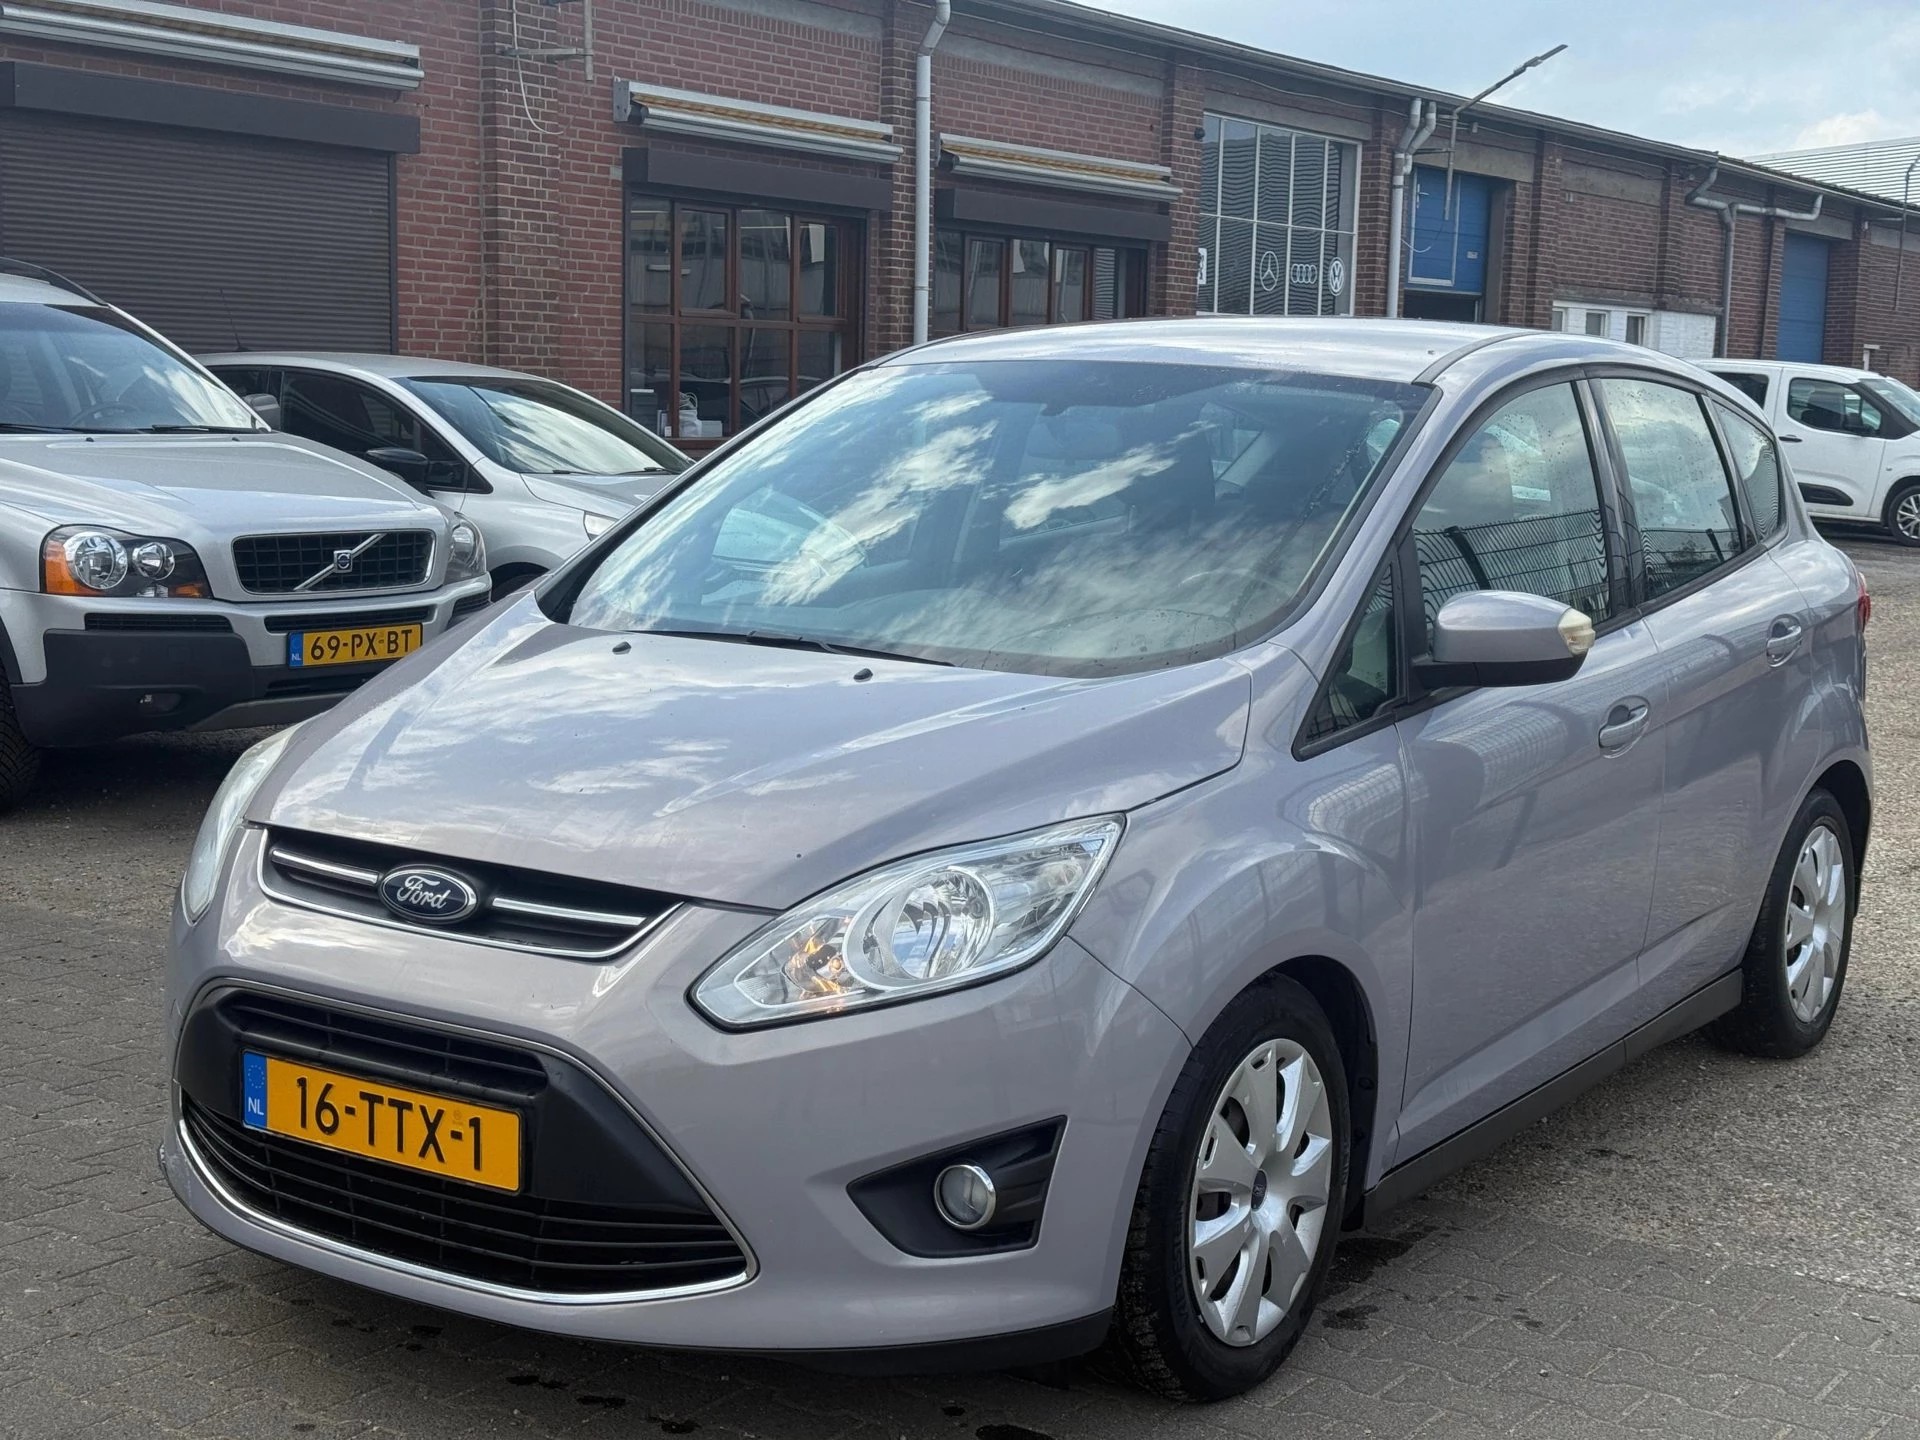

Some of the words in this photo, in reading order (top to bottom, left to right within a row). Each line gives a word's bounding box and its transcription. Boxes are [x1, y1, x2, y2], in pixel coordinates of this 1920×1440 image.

[291, 653, 302, 661] NL
[310, 629, 413, 661] 69-PX-BT
[396, 875, 451, 909] Ford
[248, 1096, 265, 1116] NL
[296, 1076, 482, 1172] 16-TTX-1
